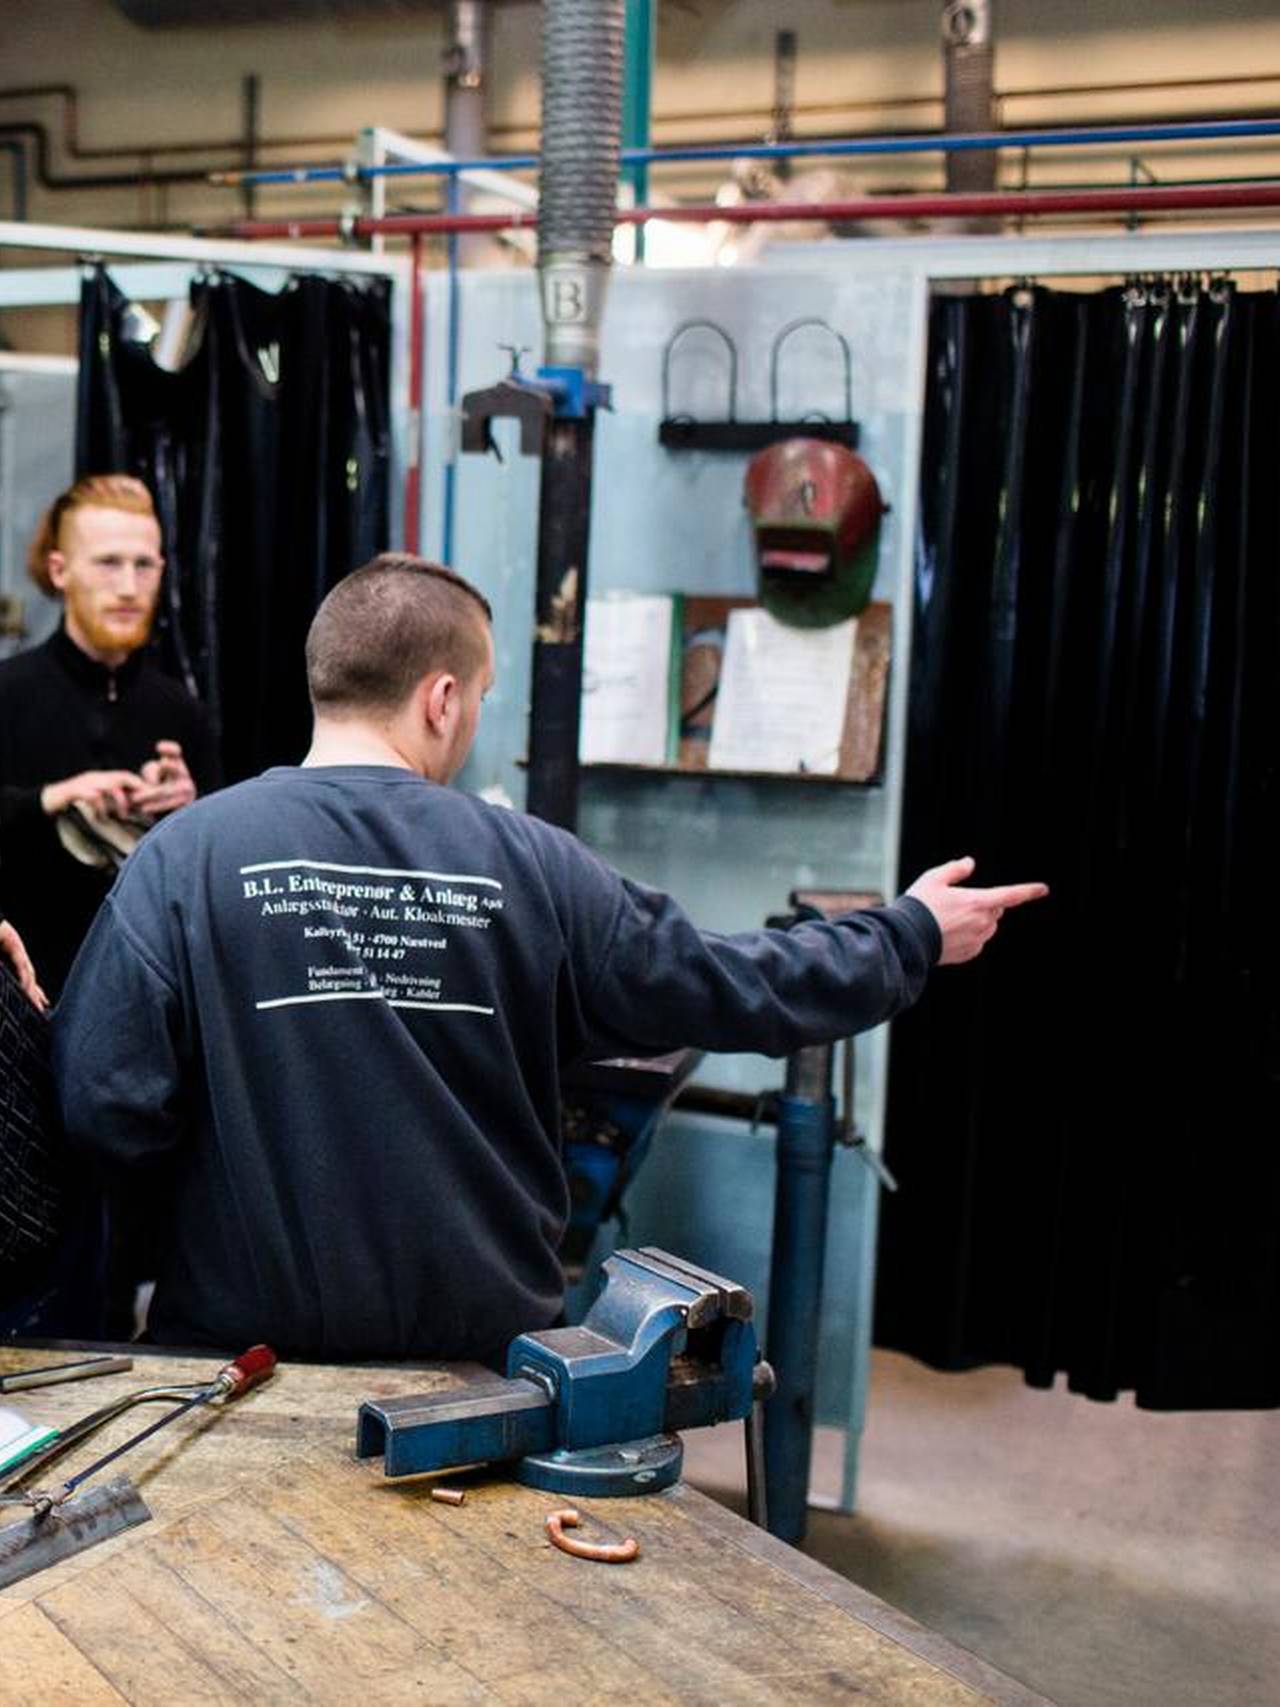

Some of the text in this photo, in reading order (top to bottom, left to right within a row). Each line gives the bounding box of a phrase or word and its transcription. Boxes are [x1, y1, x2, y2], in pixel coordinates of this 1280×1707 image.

[554, 280, 582, 320] B
[242, 877, 285, 899] B.L.
[399, 883, 417, 902] &
[404, 906, 493, 929] Kloakmester
